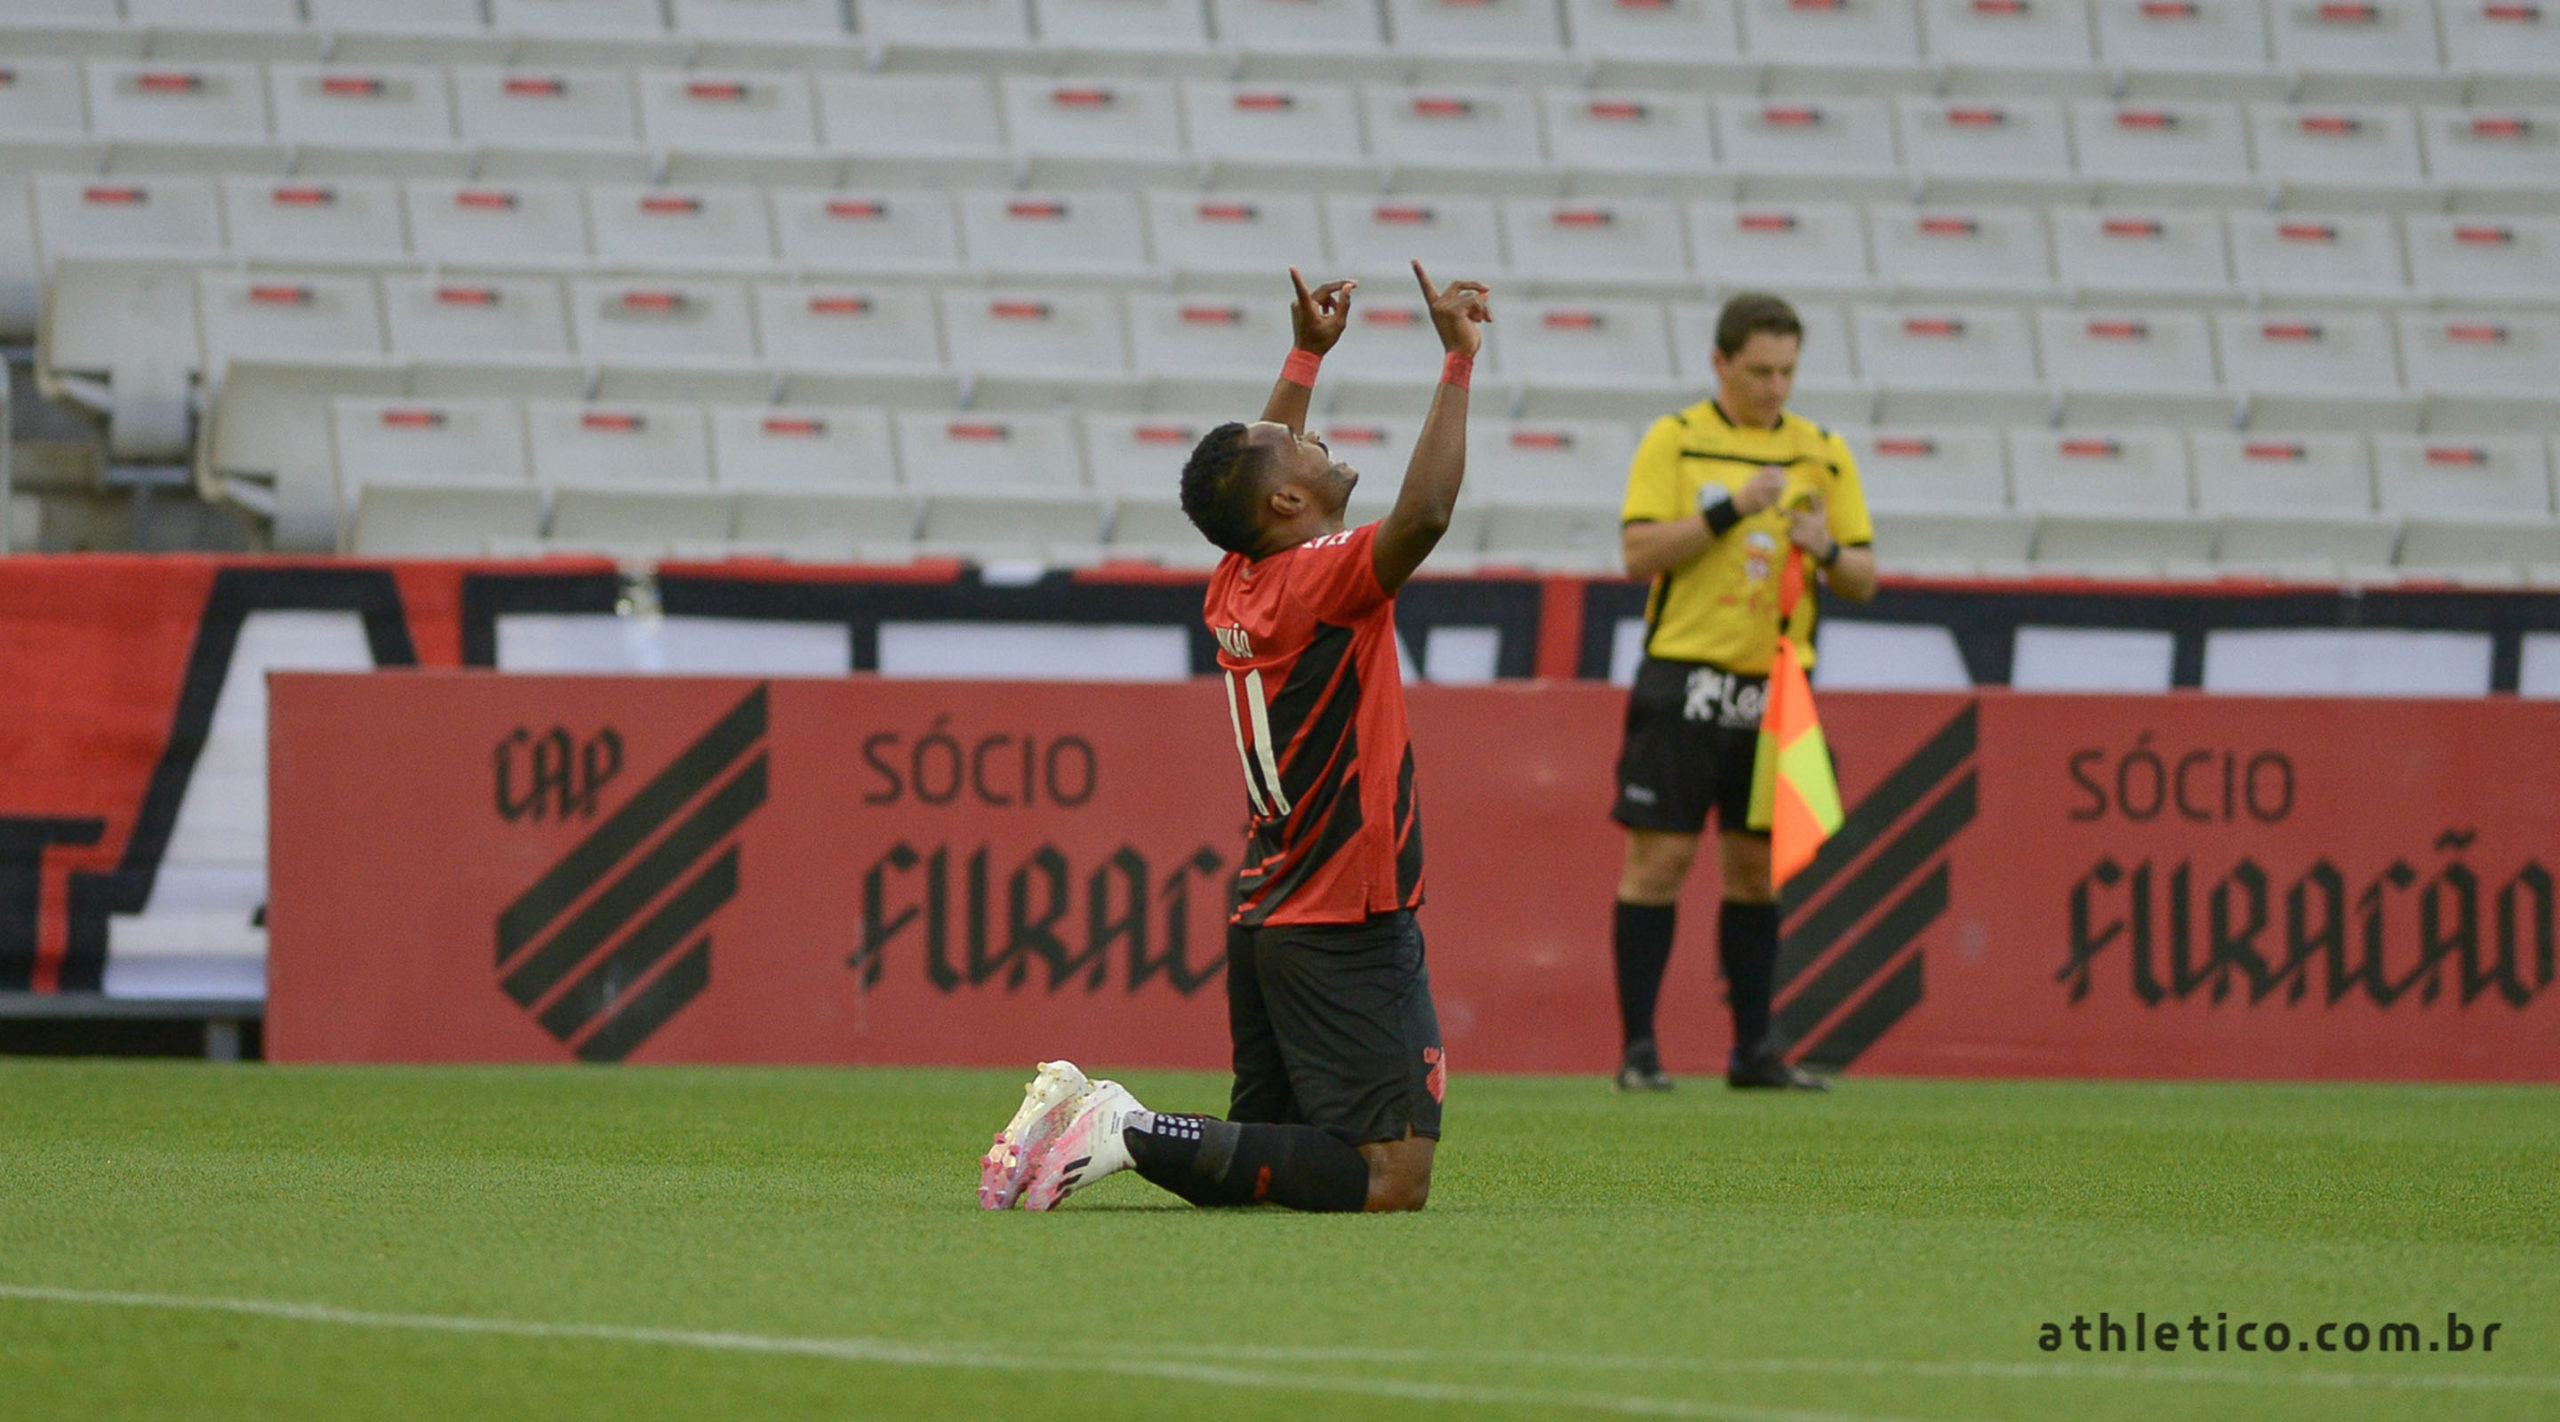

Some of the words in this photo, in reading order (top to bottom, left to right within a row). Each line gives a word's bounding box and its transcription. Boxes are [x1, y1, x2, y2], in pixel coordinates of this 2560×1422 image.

[493, 725, 624, 822] CAP
[862, 713, 1097, 808] SÓCIO
[1224, 668, 1292, 817] 11
[2068, 731, 2296, 822] SÓCIO
[846, 840, 1232, 995] FURAC
[2053, 826, 2557, 1008] FURACÃO
